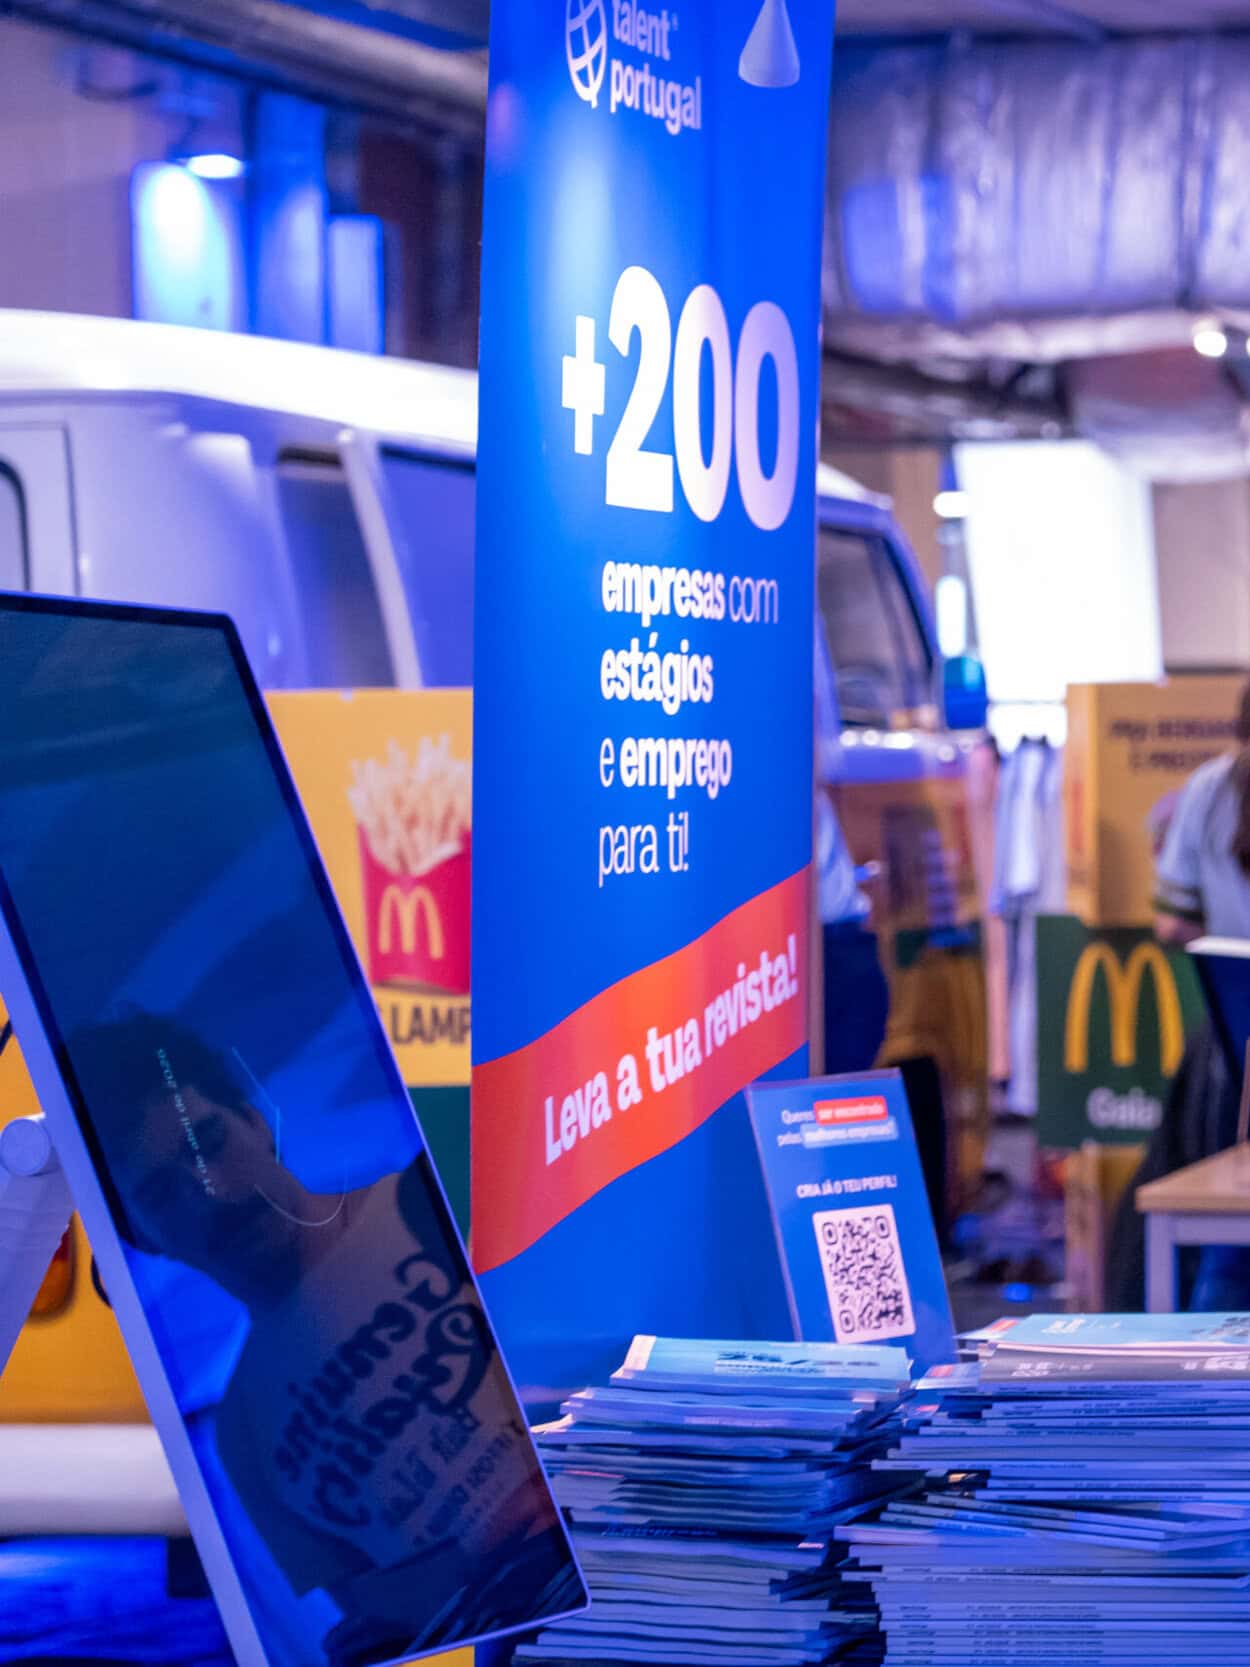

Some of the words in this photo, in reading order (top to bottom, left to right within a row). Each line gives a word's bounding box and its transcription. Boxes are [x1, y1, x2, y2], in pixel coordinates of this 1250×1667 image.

[610, 59, 702, 135] portugal
[562, 265, 801, 531] +200
[602, 560, 725, 627] empresas
[728, 576, 779, 624] com
[601, 632, 714, 715] estágios
[600, 738, 615, 787] e
[619, 737, 732, 799] emprego
[598, 823, 660, 888] para
[667, 811, 689, 872] ti!
[544, 1071, 613, 1167] Leva
[616, 1053, 643, 1112] a
[645, 1018, 703, 1093] tua
[703, 933, 799, 1057] revista!
